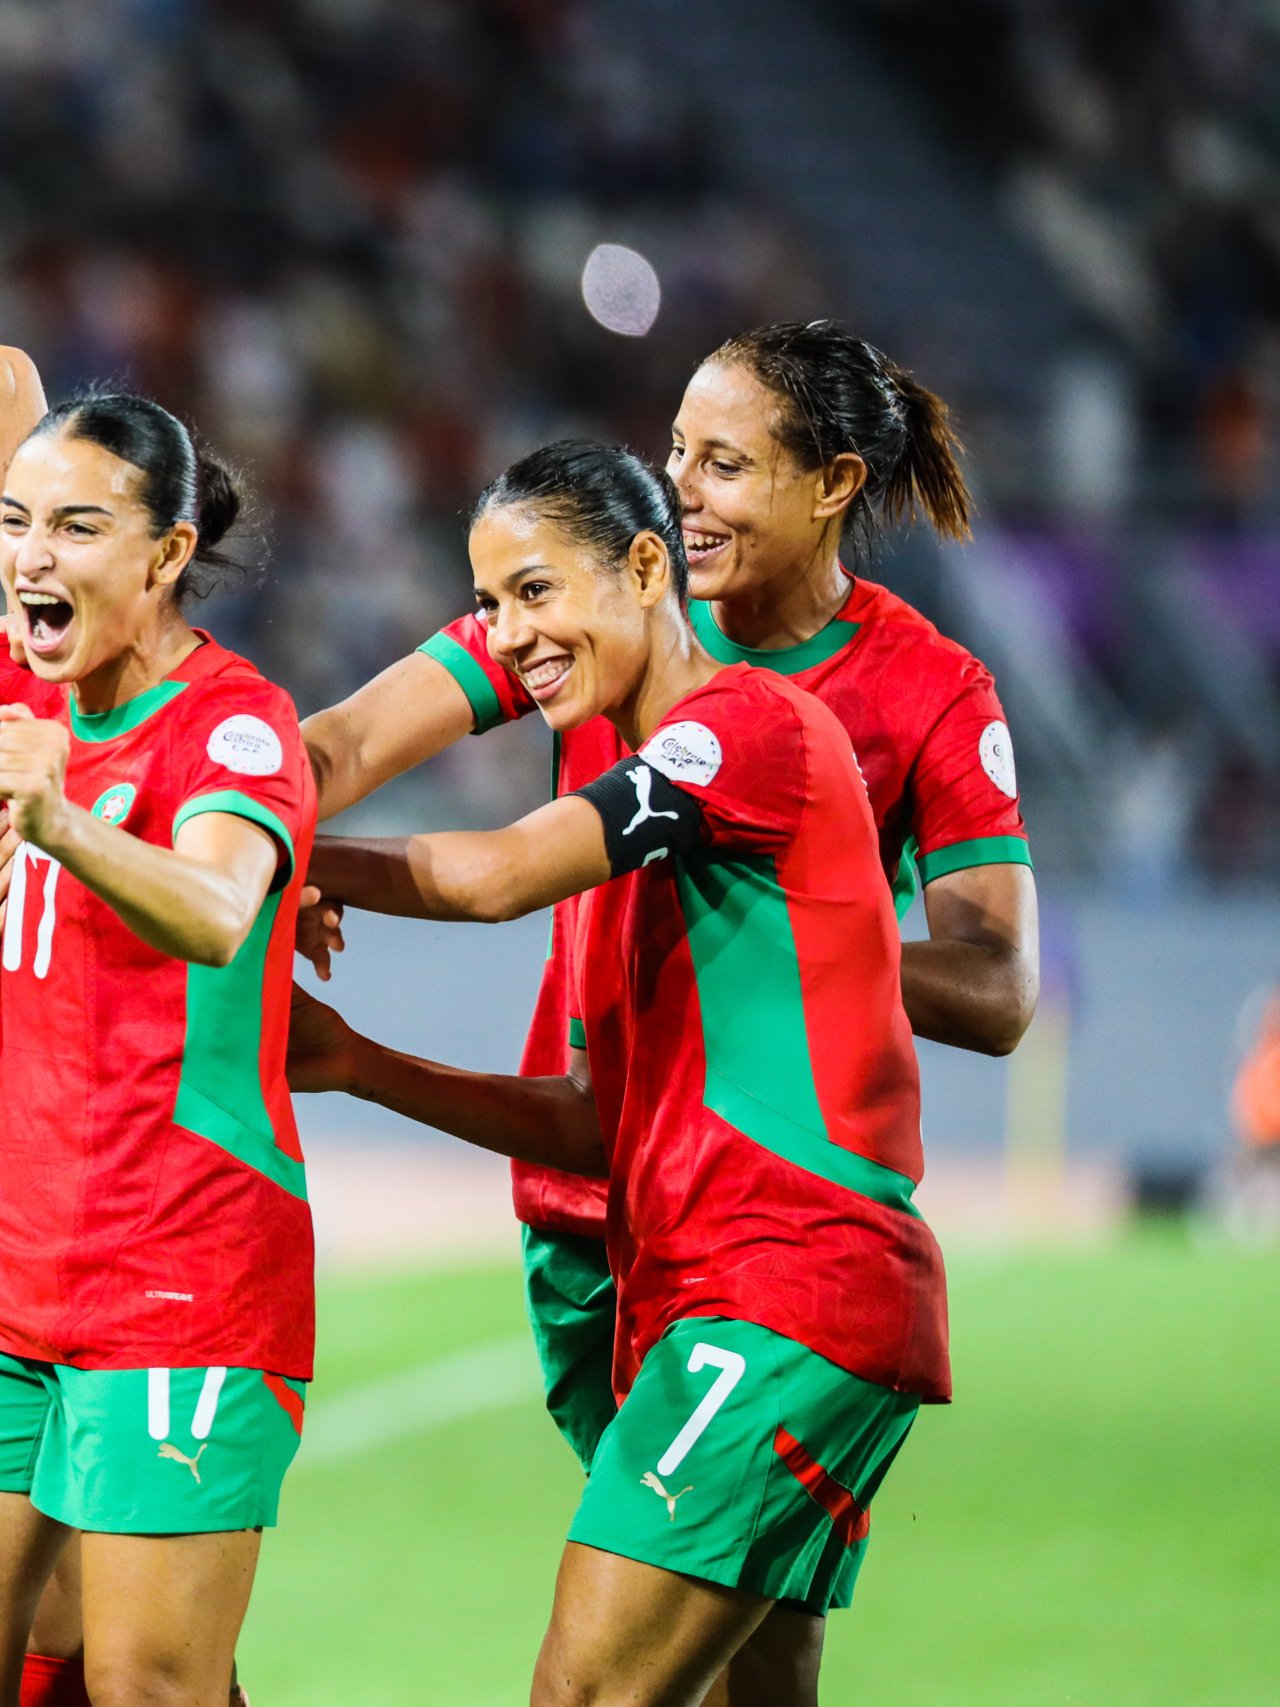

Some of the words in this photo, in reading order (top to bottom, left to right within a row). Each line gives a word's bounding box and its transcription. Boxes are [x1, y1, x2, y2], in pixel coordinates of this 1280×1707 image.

[2, 840, 62, 979] 17
[147, 1366, 228, 1441] 17
[657, 1342, 746, 1477] 7
